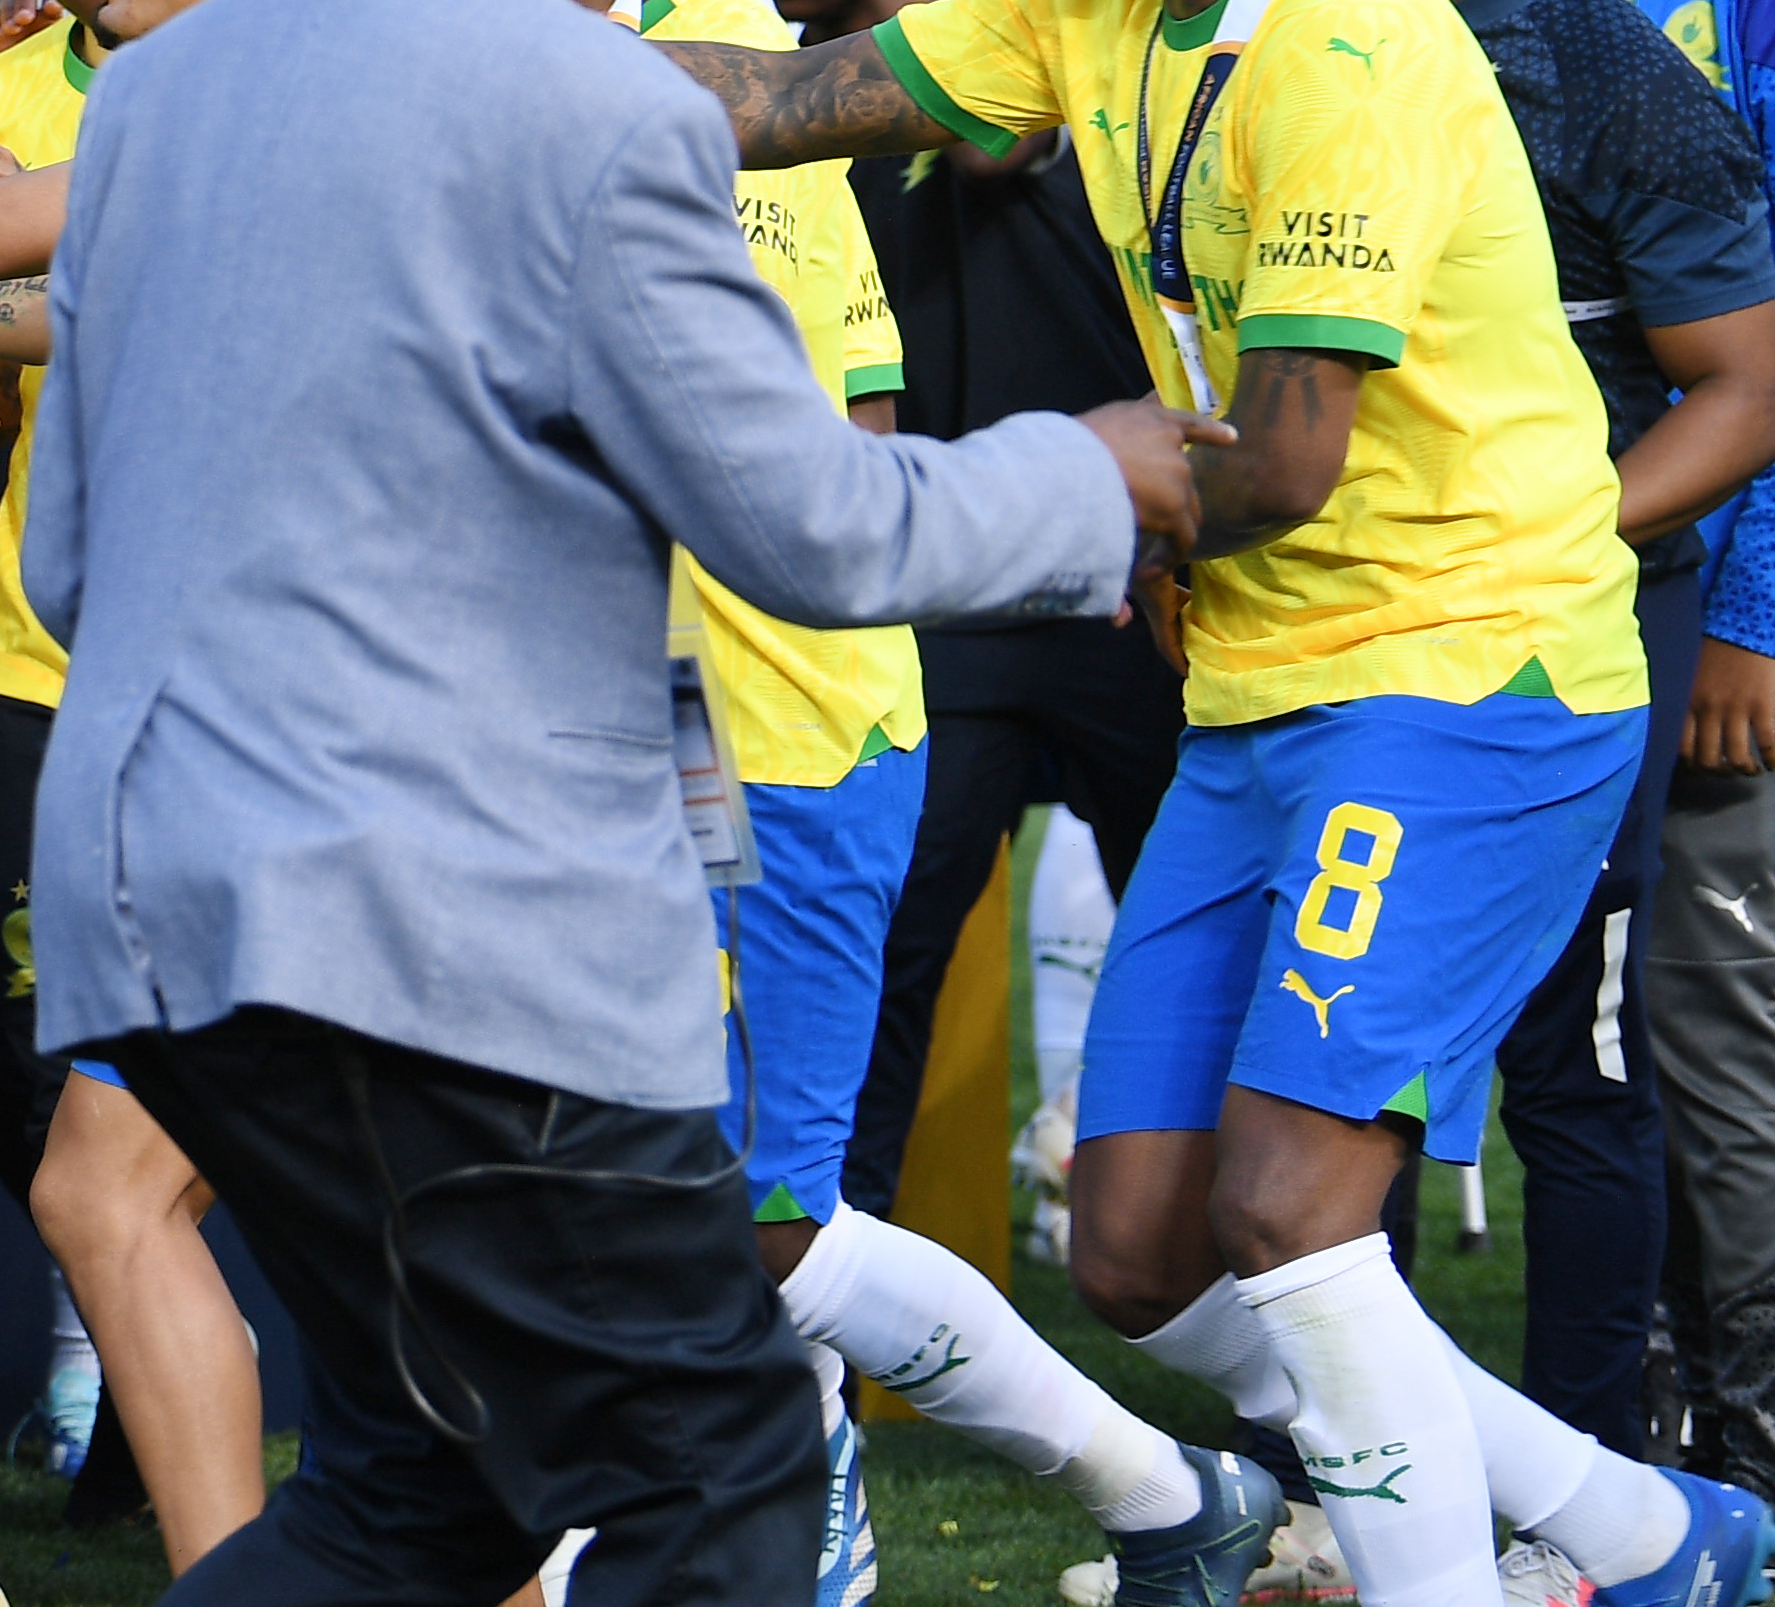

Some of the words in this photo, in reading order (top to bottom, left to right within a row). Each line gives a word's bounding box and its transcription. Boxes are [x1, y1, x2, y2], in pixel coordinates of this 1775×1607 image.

[732, 194, 796, 236] VISIT
[1281, 209, 1370, 238] VISIT
[1257, 241, 1396, 273] RWANDA
[1294, 801, 1404, 961] 8
